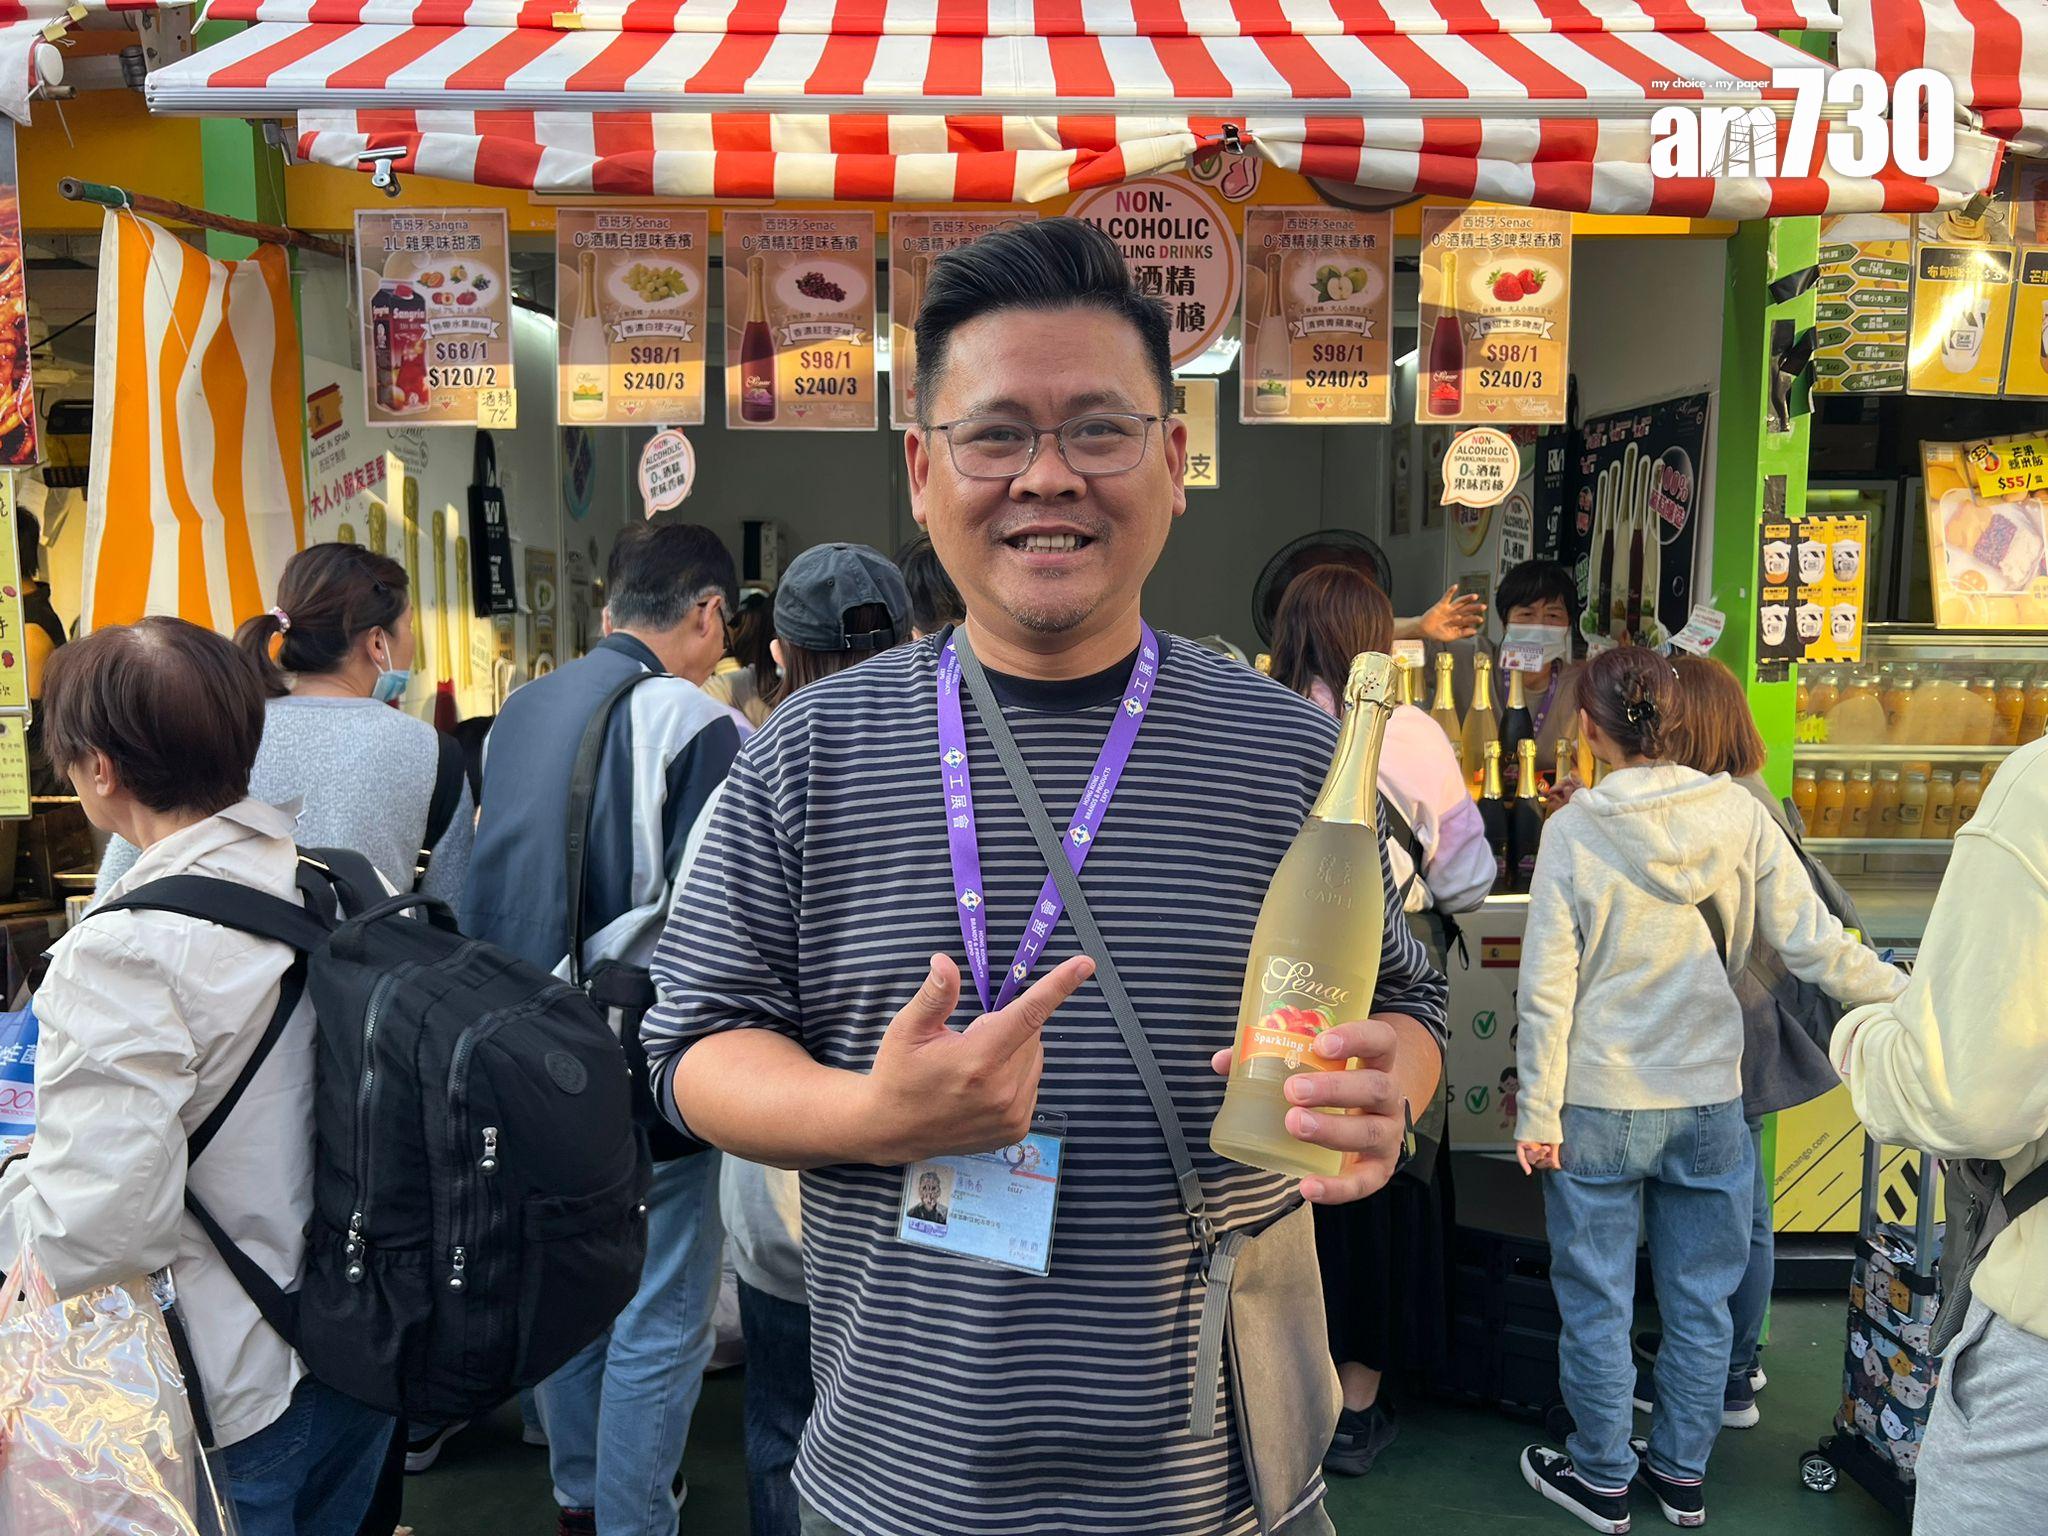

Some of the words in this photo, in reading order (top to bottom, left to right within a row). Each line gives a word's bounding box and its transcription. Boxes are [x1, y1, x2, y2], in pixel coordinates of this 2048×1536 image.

[1116, 191, 1172, 213] NON-
[393, 219, 425, 230] 西班牙
[428, 220, 468, 233] Sangria
[599, 215, 632, 228] 西班牙
[635, 217, 669, 229] Senac
[766, 219, 799, 230] 西班牙
[802, 219, 836, 231] Senac
[1287, 219, 1319, 230] 西班牙
[1322, 219, 1354, 230] Senac
[1463, 216, 1497, 228] 西班牙
[1499, 216, 1532, 228] Senac
[384, 236, 401, 250] 1L
[406, 235, 481, 250] 雜果味甜酒
[1160, 245, 1213, 259] DRINKS
[393, 308, 425, 322] Sangria
[436, 342, 487, 360] $68/1
[631, 346, 680, 364] $98/1
[800, 351, 850, 369] $98/1
[1312, 344, 1364, 362] $98/1
[1487, 344, 1537, 362] $98/1
[429, 367, 495, 388] $120/2
[624, 371, 684, 390] $240/3
[795, 377, 857, 395] $240/3
[1306, 369, 1368, 388] $240/3
[1480, 369, 1542, 388] $240/3
[488, 408, 508, 423] 7%
[310, 443, 326, 459] MADE
[334, 429, 351, 447] SPAIN
[646, 442, 681, 464] ALCOHOLIC
[1457, 446, 1509, 456] ALCOHOLIC
[311, 455, 386, 519] 大人小朋友至愛
[1134, 646, 1156, 693] 工展會
[949, 775, 969, 830] 工展會
[1024, 899, 1057, 957] 工展會
[1261, 956, 1350, 1006] Senac
[1253, 1031, 1304, 1052] Sparkling
